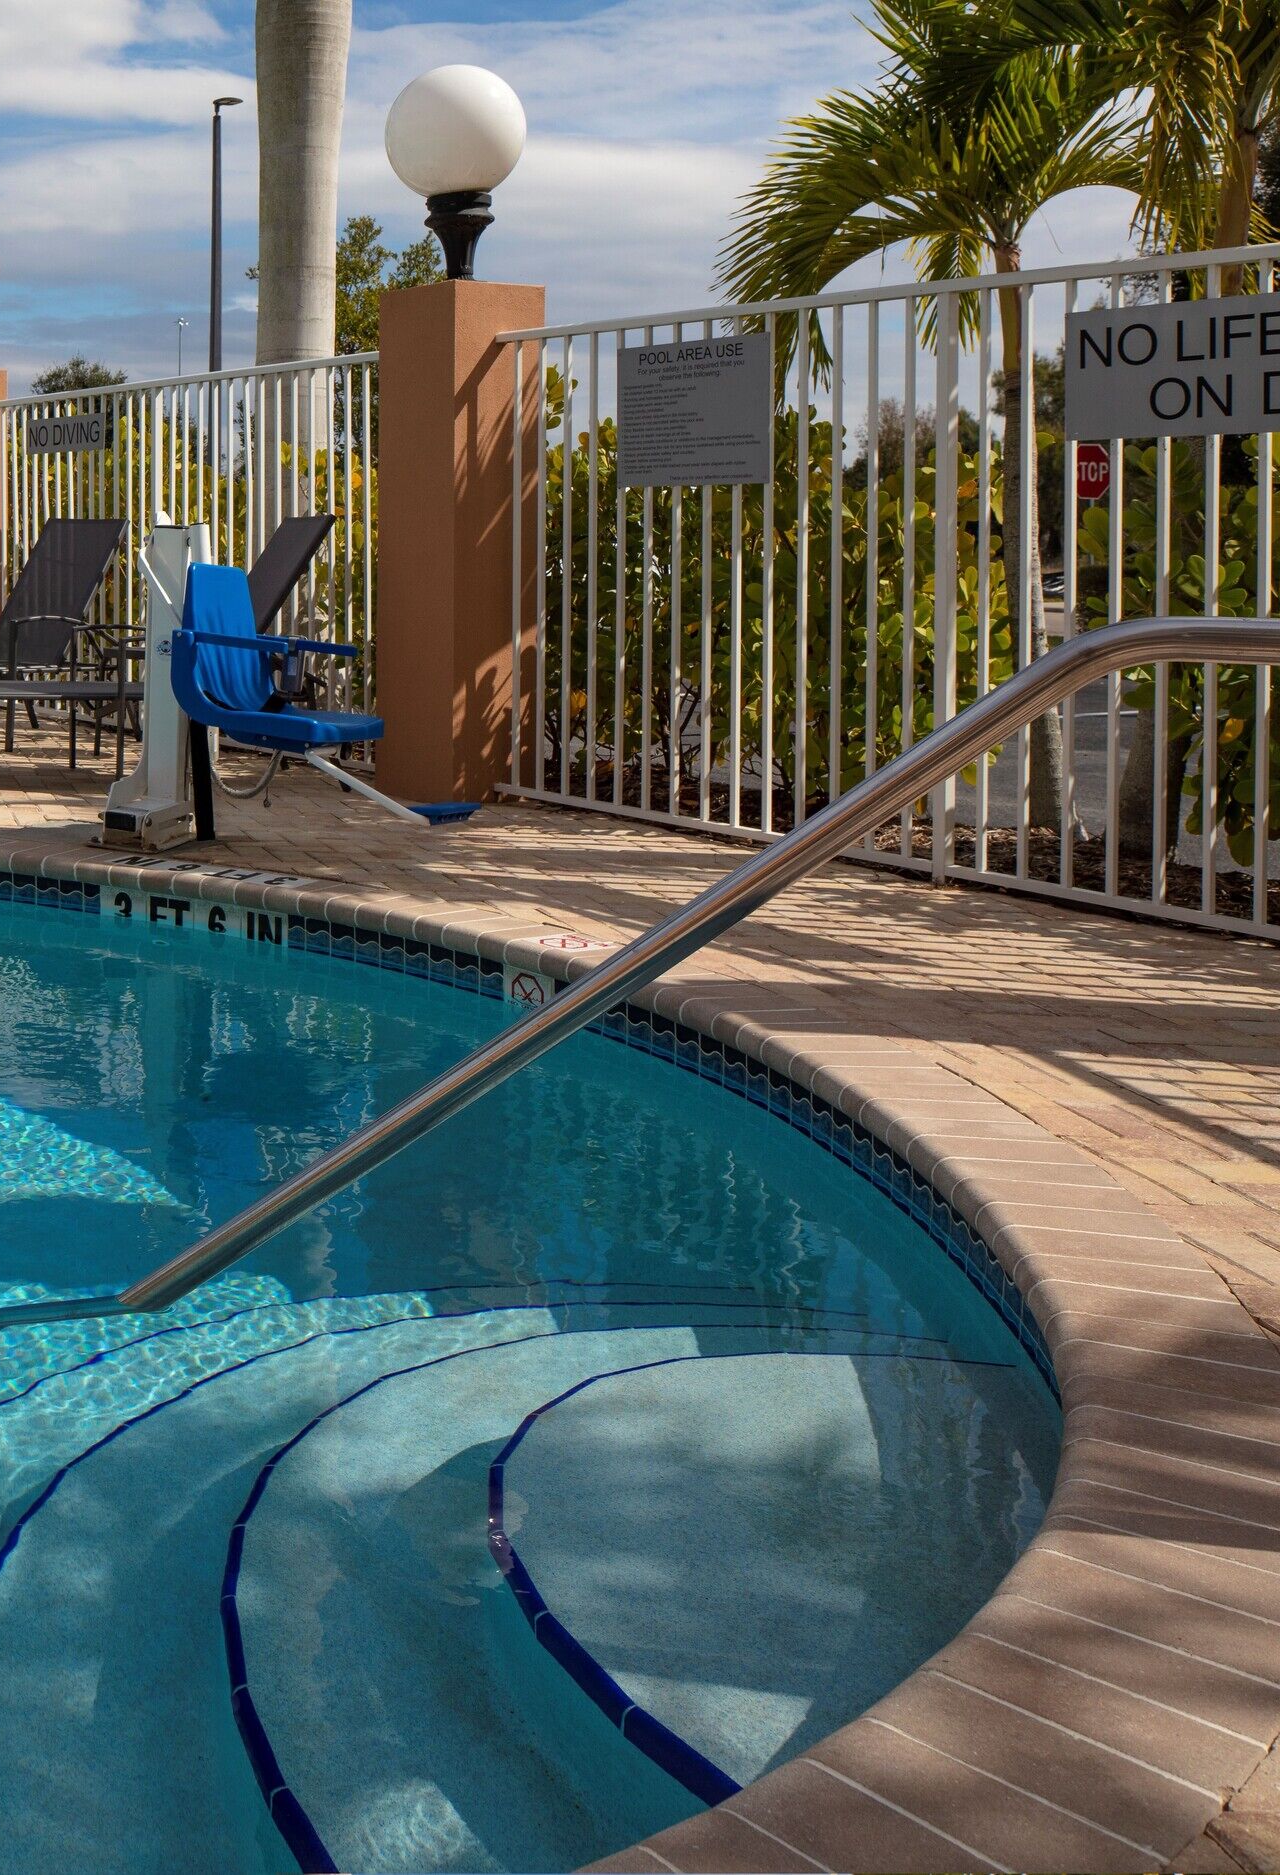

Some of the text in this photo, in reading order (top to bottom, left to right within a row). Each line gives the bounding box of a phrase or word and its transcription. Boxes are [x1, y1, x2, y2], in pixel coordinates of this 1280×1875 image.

[639, 343, 744, 366] POOL AREA USE
[1080, 323, 1158, 369] NO
[649, 368, 662, 376] your
[694, 362, 719, 372] required
[734, 360, 744, 368] you
[658, 374, 682, 382] observe
[1150, 374, 1233, 420] ON
[29, 420, 100, 448] NO DIVING
[112, 856, 164, 868] IN
[201, 868, 262, 881] FT
[263, 876, 299, 886] 3
[150, 896, 191, 926] FT
[208, 906, 226, 933] 6
[246, 911, 283, 946] IN
